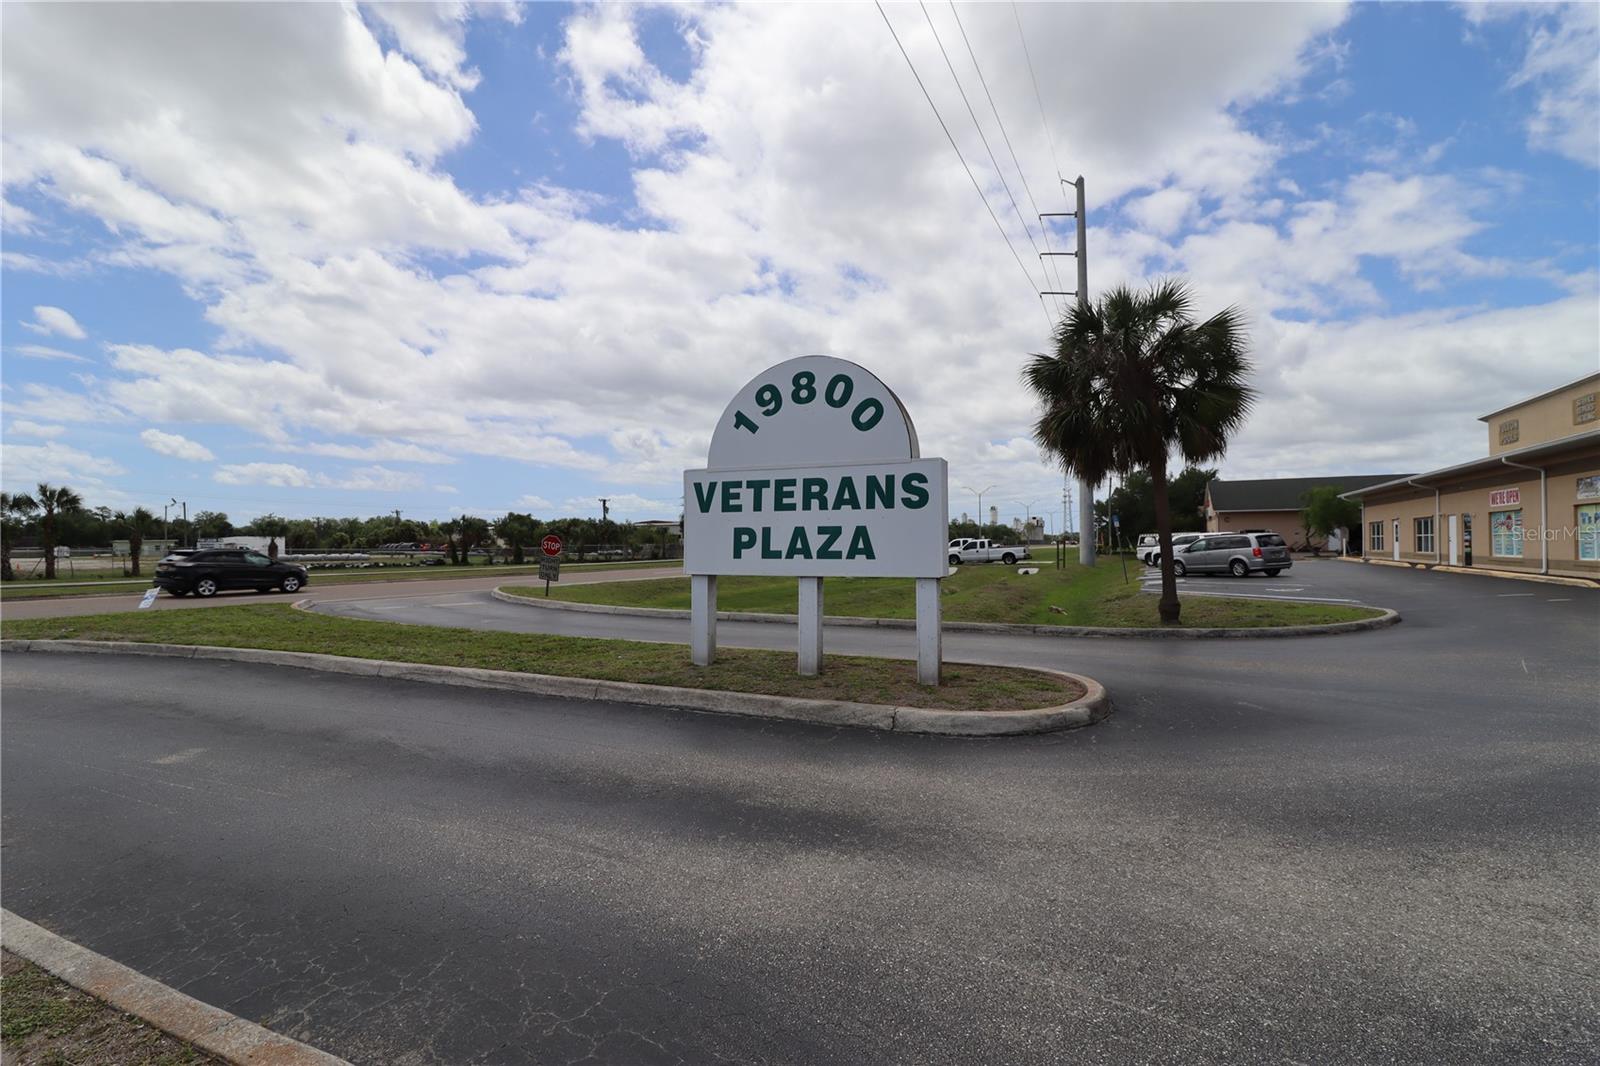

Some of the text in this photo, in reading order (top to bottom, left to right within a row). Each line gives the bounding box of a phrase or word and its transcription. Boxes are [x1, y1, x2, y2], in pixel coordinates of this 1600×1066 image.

[734, 371, 884, 435] 19800
[693, 472, 930, 514] VETERANS
[1505, 489, 1519, 504] OPEN
[543, 541, 560, 550] STOP
[732, 525, 877, 560] PLAZA
